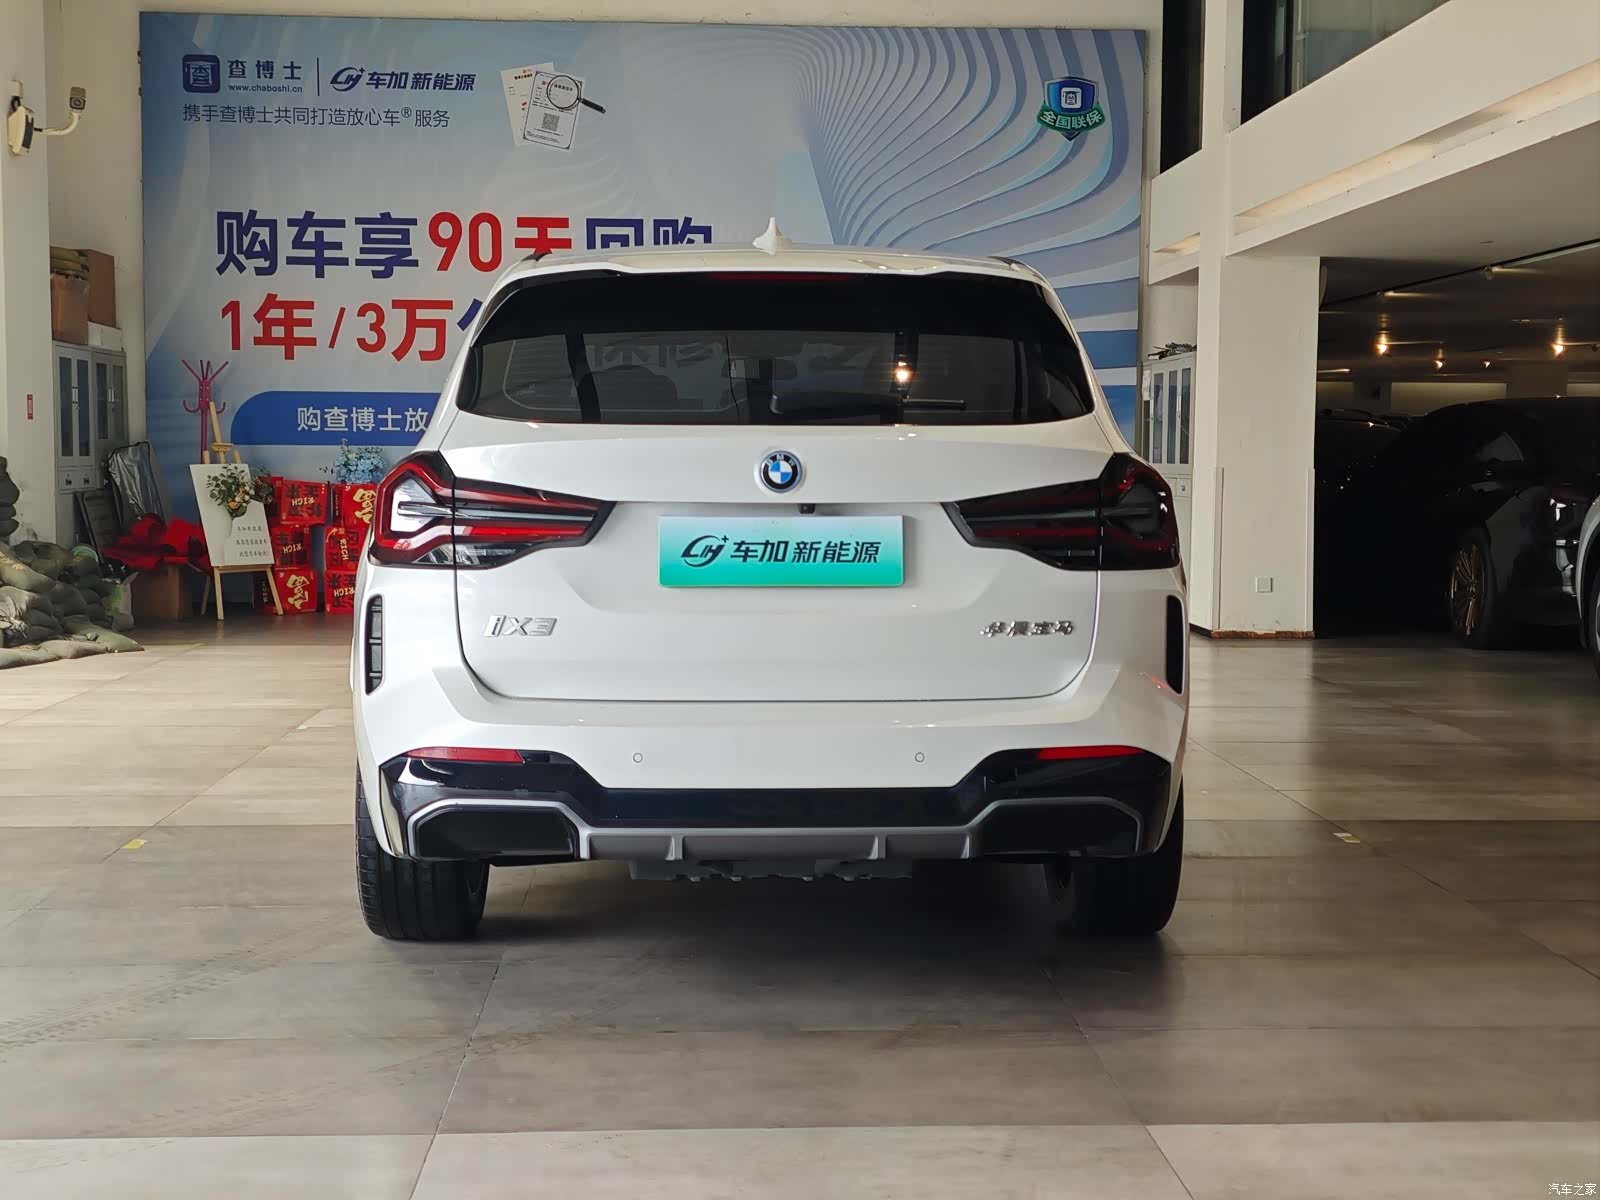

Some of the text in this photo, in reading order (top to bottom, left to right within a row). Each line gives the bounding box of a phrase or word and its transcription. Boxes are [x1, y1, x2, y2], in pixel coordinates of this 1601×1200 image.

[227, 59, 302, 80] 查博士
[228, 83, 303, 93] www.chaboshi.cn
[366, 71, 476, 91] 车加新能源
[182, 103, 451, 128] 携手查博士共同打造放心车®服务
[1040, 110, 1103, 129] 全国联保
[221, 293, 484, 362] 1年/3万
[297, 406, 429, 433] 购查博士放
[291, 496, 315, 507] RICH
[282, 543, 303, 555] RICH
[339, 538, 350, 561] RICH
[730, 539, 881, 563] 车加新能源
